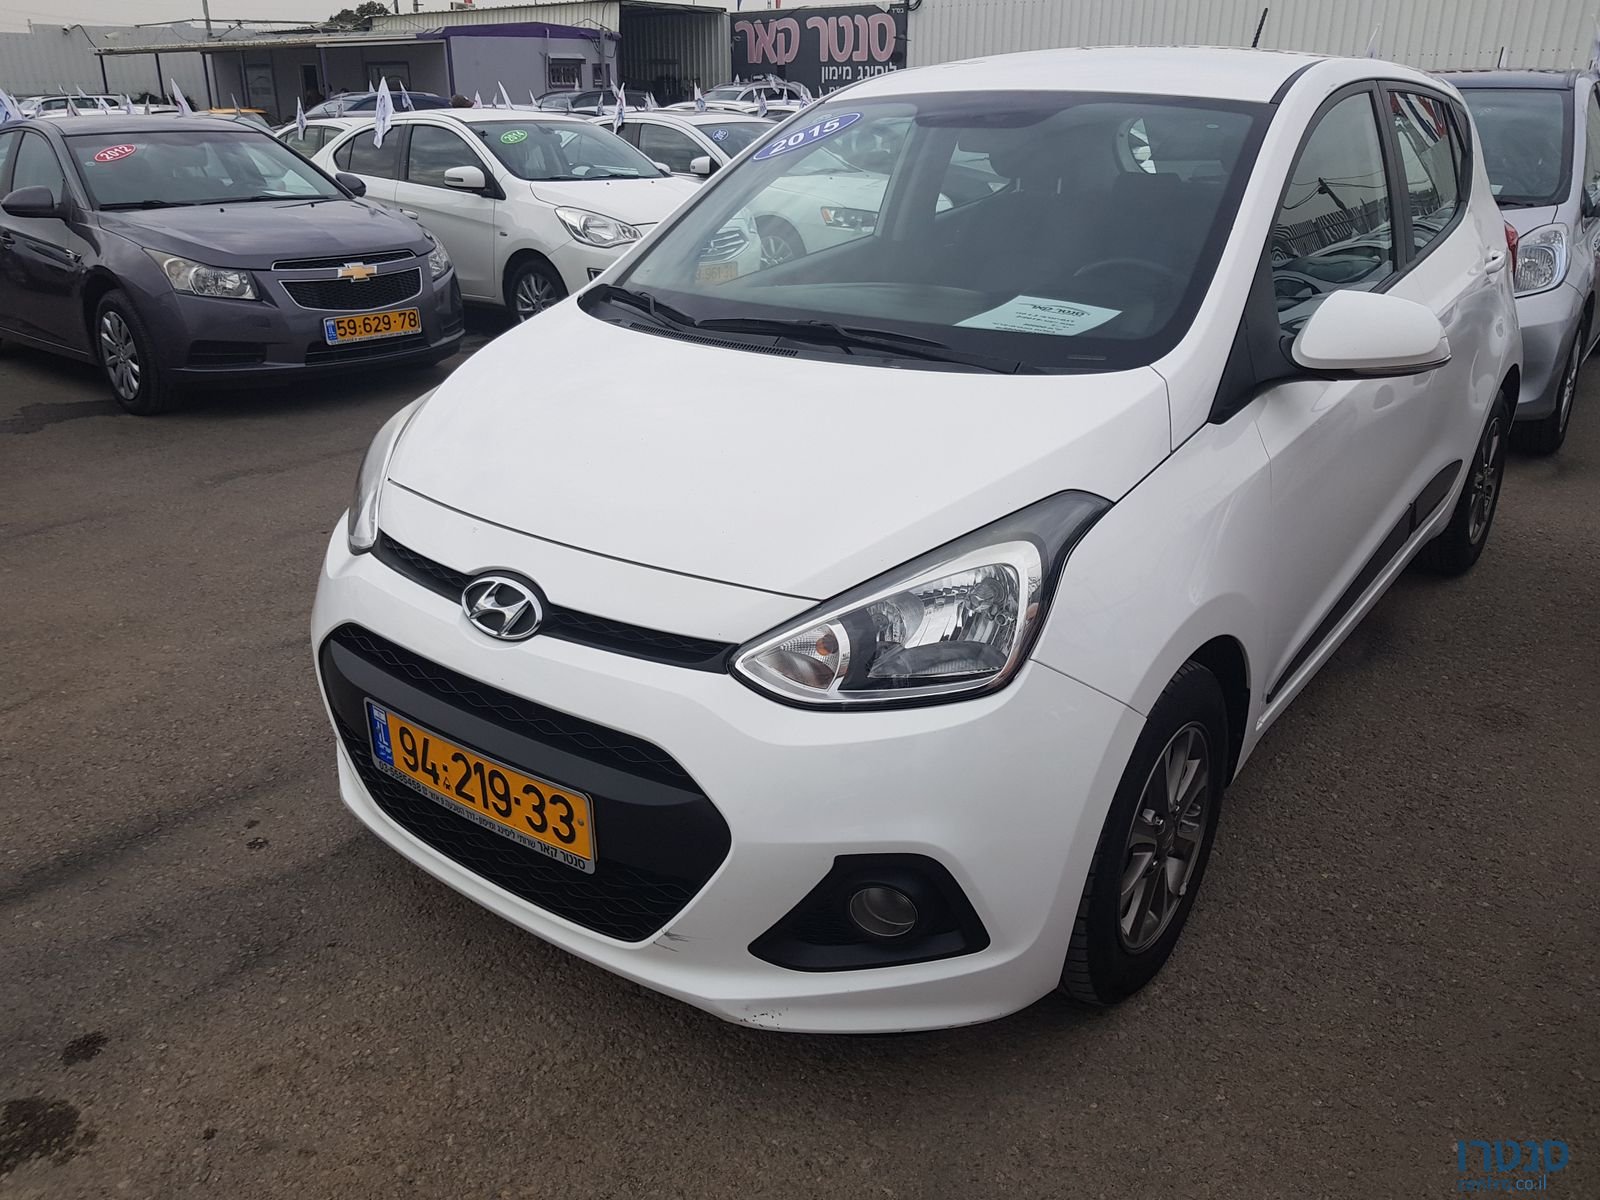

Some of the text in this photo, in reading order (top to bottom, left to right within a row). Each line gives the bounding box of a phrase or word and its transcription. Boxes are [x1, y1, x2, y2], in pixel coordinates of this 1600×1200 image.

[734, 13, 897, 65] סנטר קאר
[821, 65, 852, 84] מימון
[769, 118, 841, 155] 2015
[100, 146, 132, 160] 2012
[536, 841, 558, 858] קאר
[560, 850, 586, 870] סנטר
